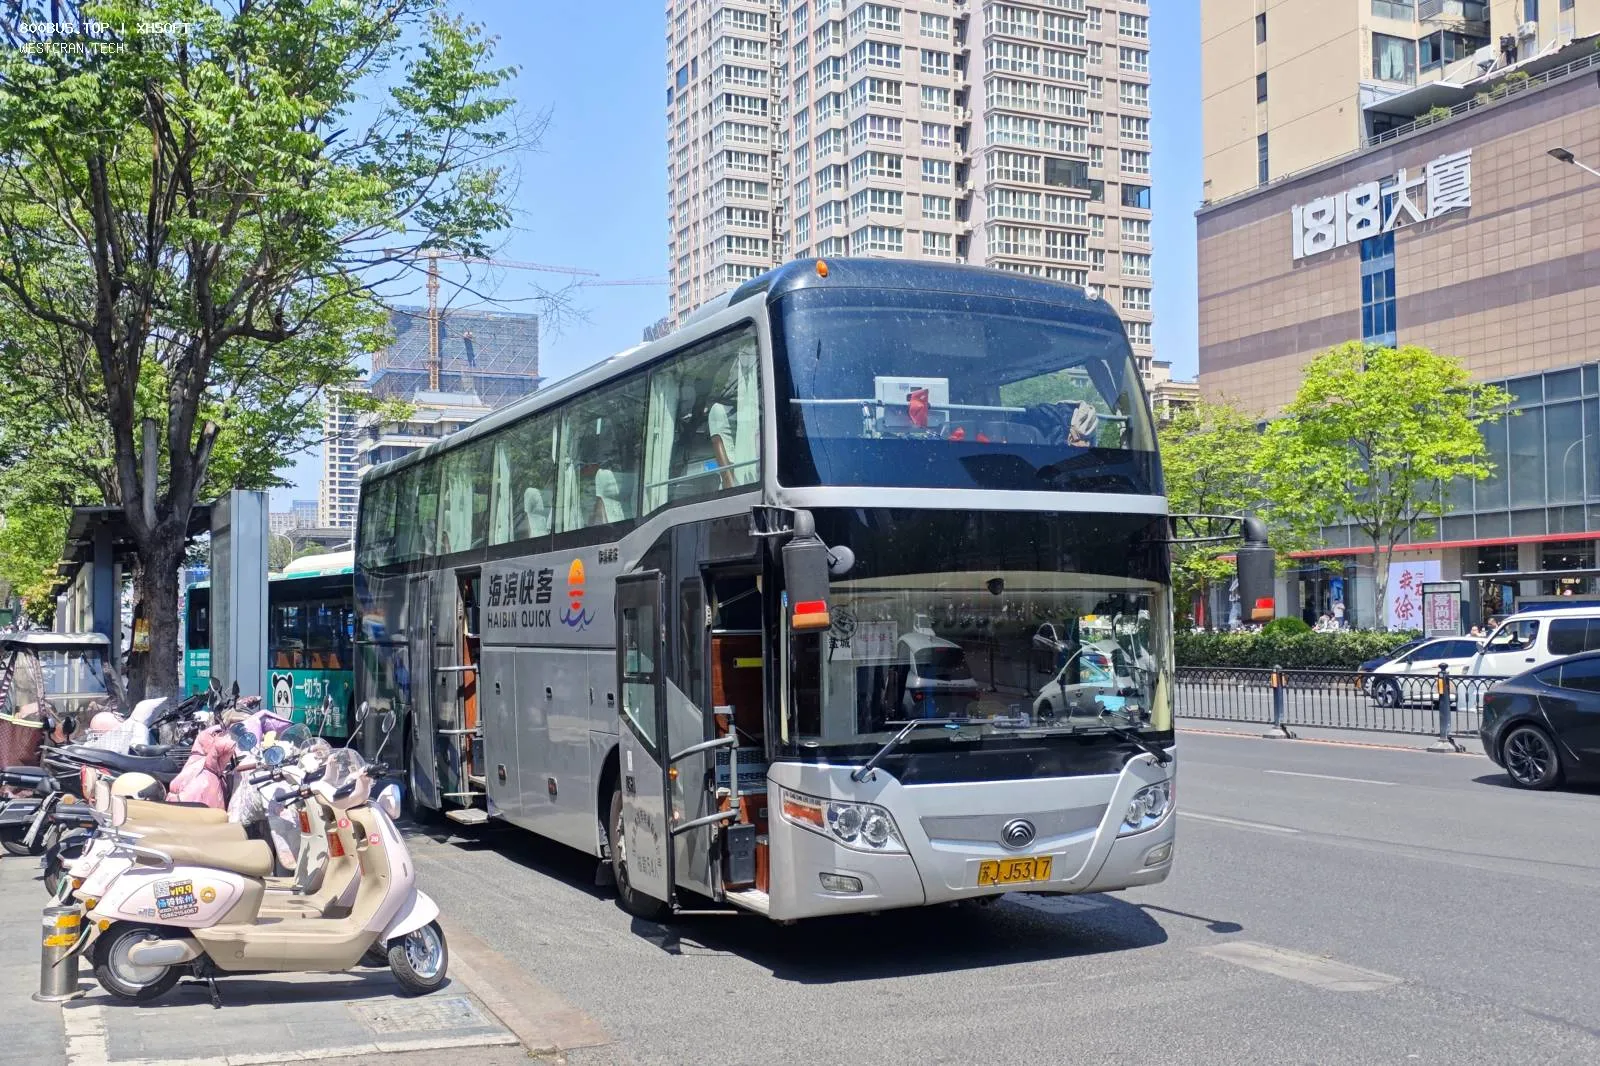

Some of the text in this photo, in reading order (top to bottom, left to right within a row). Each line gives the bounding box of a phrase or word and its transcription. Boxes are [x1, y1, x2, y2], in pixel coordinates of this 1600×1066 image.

[1291, 148, 1473, 260] 1818大厦
[487, 568, 554, 607] 海滨快客
[487, 609, 551, 629] HAIBIN QUICK
